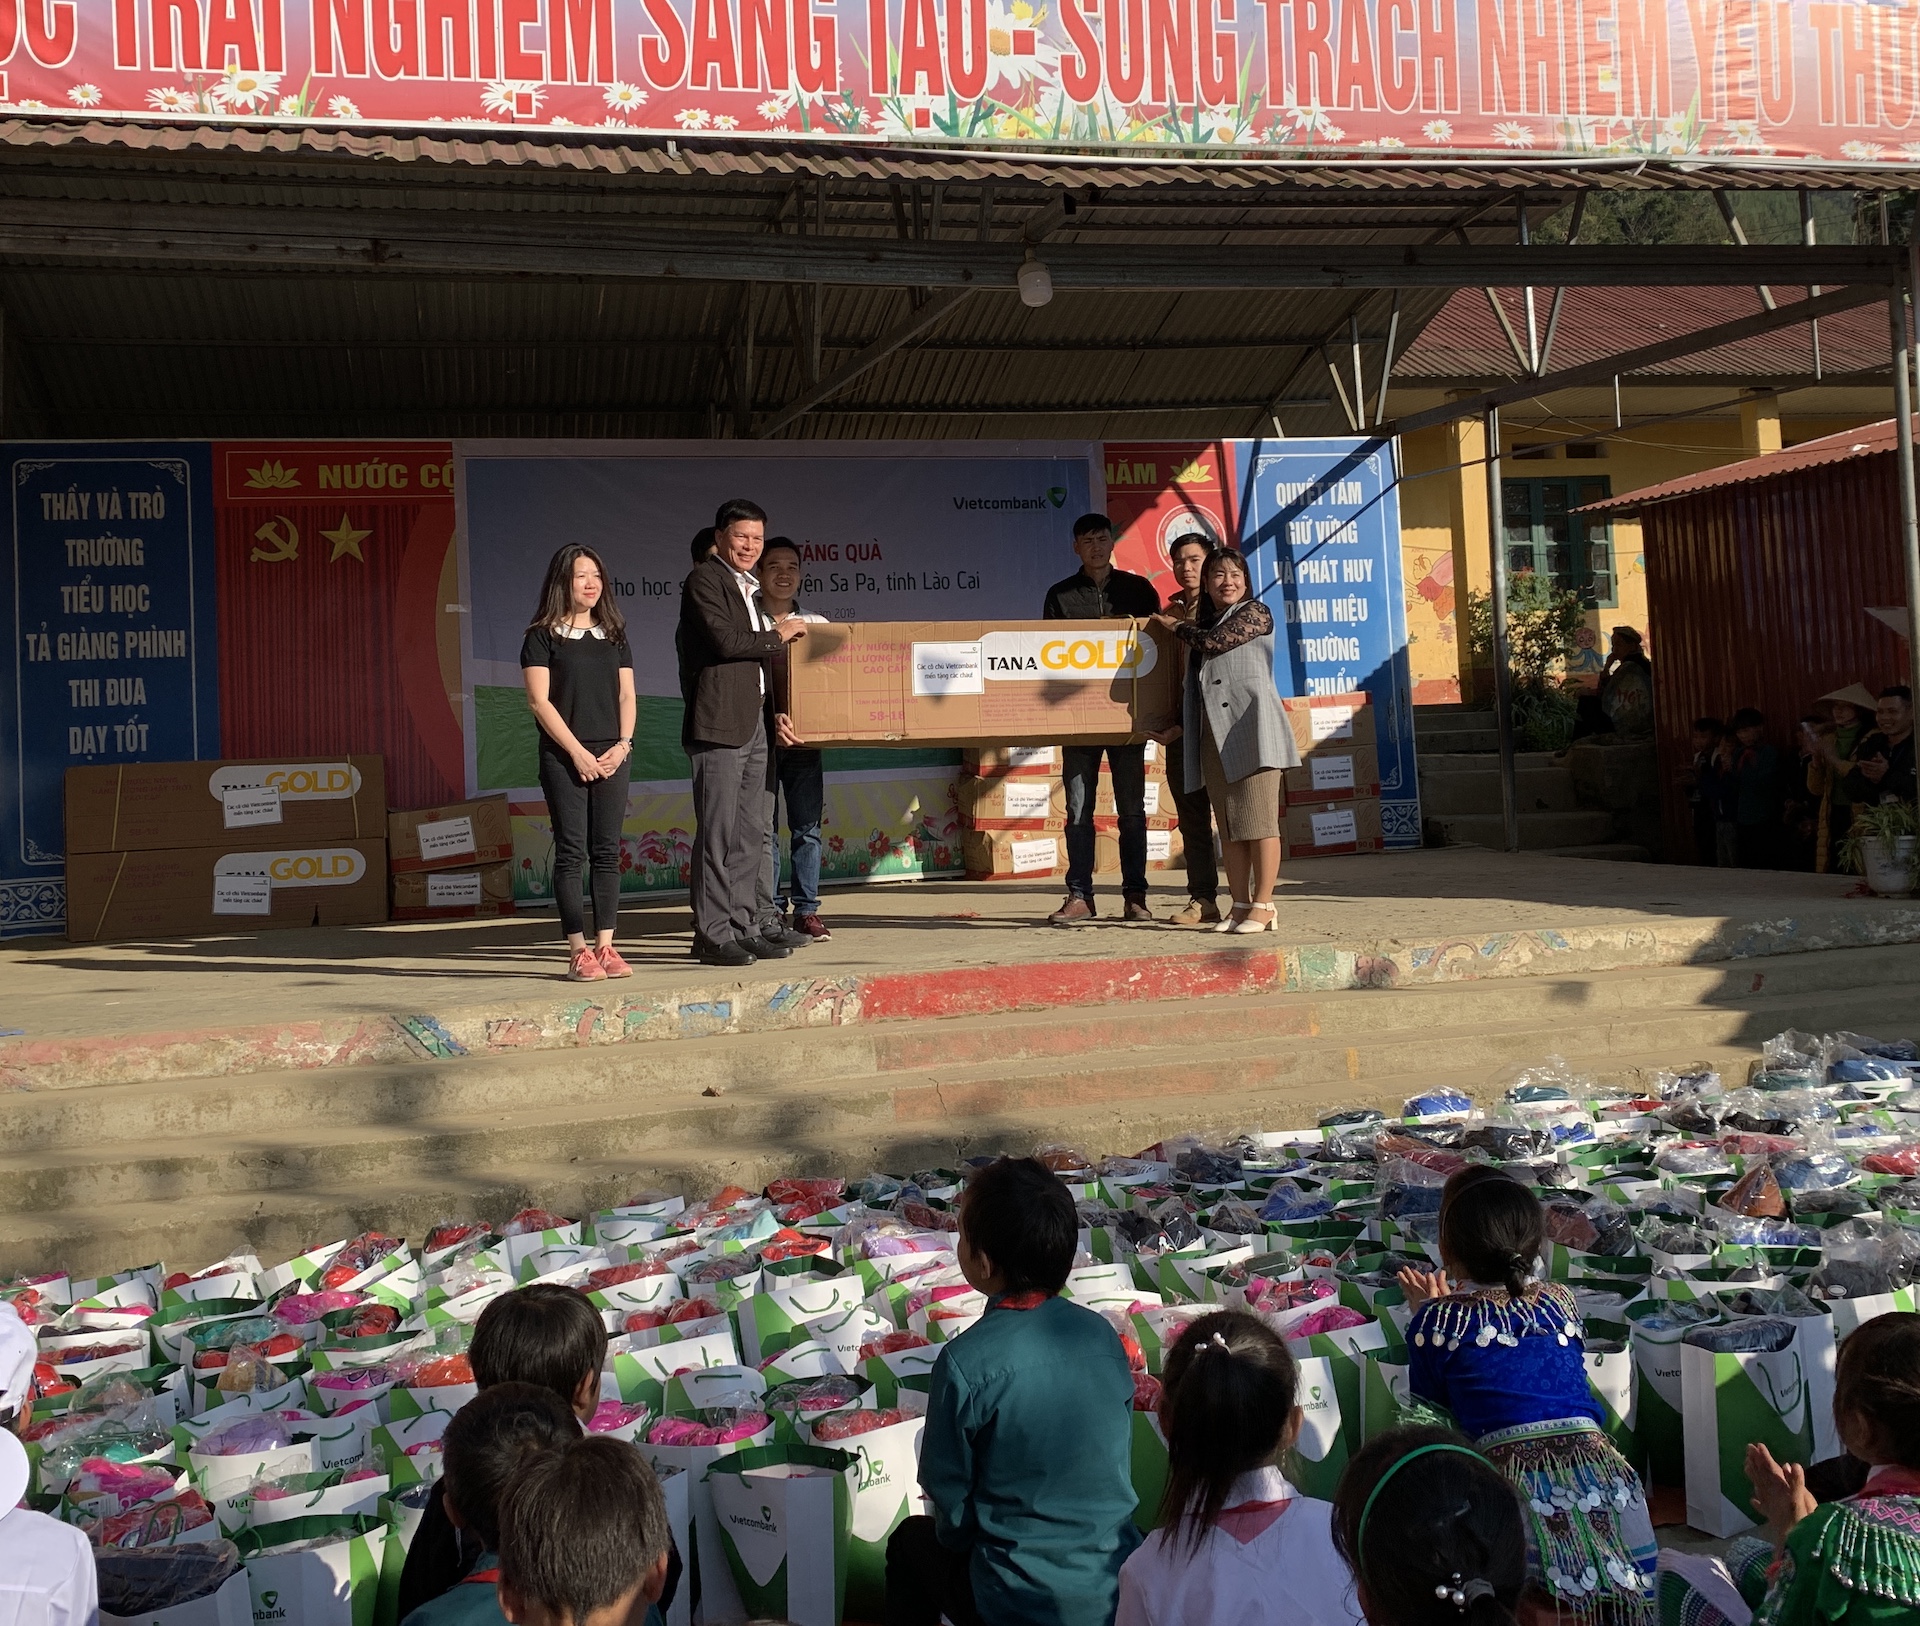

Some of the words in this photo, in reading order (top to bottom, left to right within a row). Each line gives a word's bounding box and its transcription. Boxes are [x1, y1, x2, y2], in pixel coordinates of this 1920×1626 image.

[318, 457, 408, 490] NƯỚC
[41, 483, 90, 521] THẦY
[97, 489, 122, 520] VÀ
[128, 485, 165, 520] TRÒ
[953, 496, 1046, 509] Vietcombank
[1275, 474, 1326, 508] QUYẾT
[1329, 476, 1362, 505] TÂM
[1285, 515, 1313, 545] GIỮ
[1315, 516, 1358, 544] VỮNG
[65, 531, 144, 566] TRƯỜNG
[846, 538, 882, 563] QUÀ
[830, 573, 848, 591] Sa
[856, 573, 880, 594] Pa,
[887, 572, 916, 591] tỉnh
[923, 570, 950, 590] Lào
[957, 571, 980, 589] Cai
[1274, 560, 1295, 585] VÀ
[1299, 555, 1338, 584] PHÁT
[1342, 559, 1373, 582] HUY
[61, 574, 104, 614] TIỂU
[111, 584, 150, 619] HỌC
[642, 577, 672, 600] học
[835, 608, 855, 618] 2019
[1285, 599, 1329, 623] DANH
[1332, 594, 1368, 627] HIỆU
[26, 622, 51, 662] TẢ
[57, 625, 119, 661] GIÀNG
[125, 624, 186, 659] PHÌNH
[987, 656, 1038, 671] TANA
[1040, 639, 1144, 670] GOLD
[1298, 631, 1360, 662] TRƯỜNG
[863, 665, 884, 674] CAO
[69, 679, 99, 707] THI
[105, 677, 146, 706] ĐUA
[69, 725, 108, 762] DẠY
[114, 713, 149, 752] TỐT
[265, 769, 351, 795] GOLD
[269, 855, 355, 881] GOLD
[729, 1514, 777, 1533] Vietcombank
